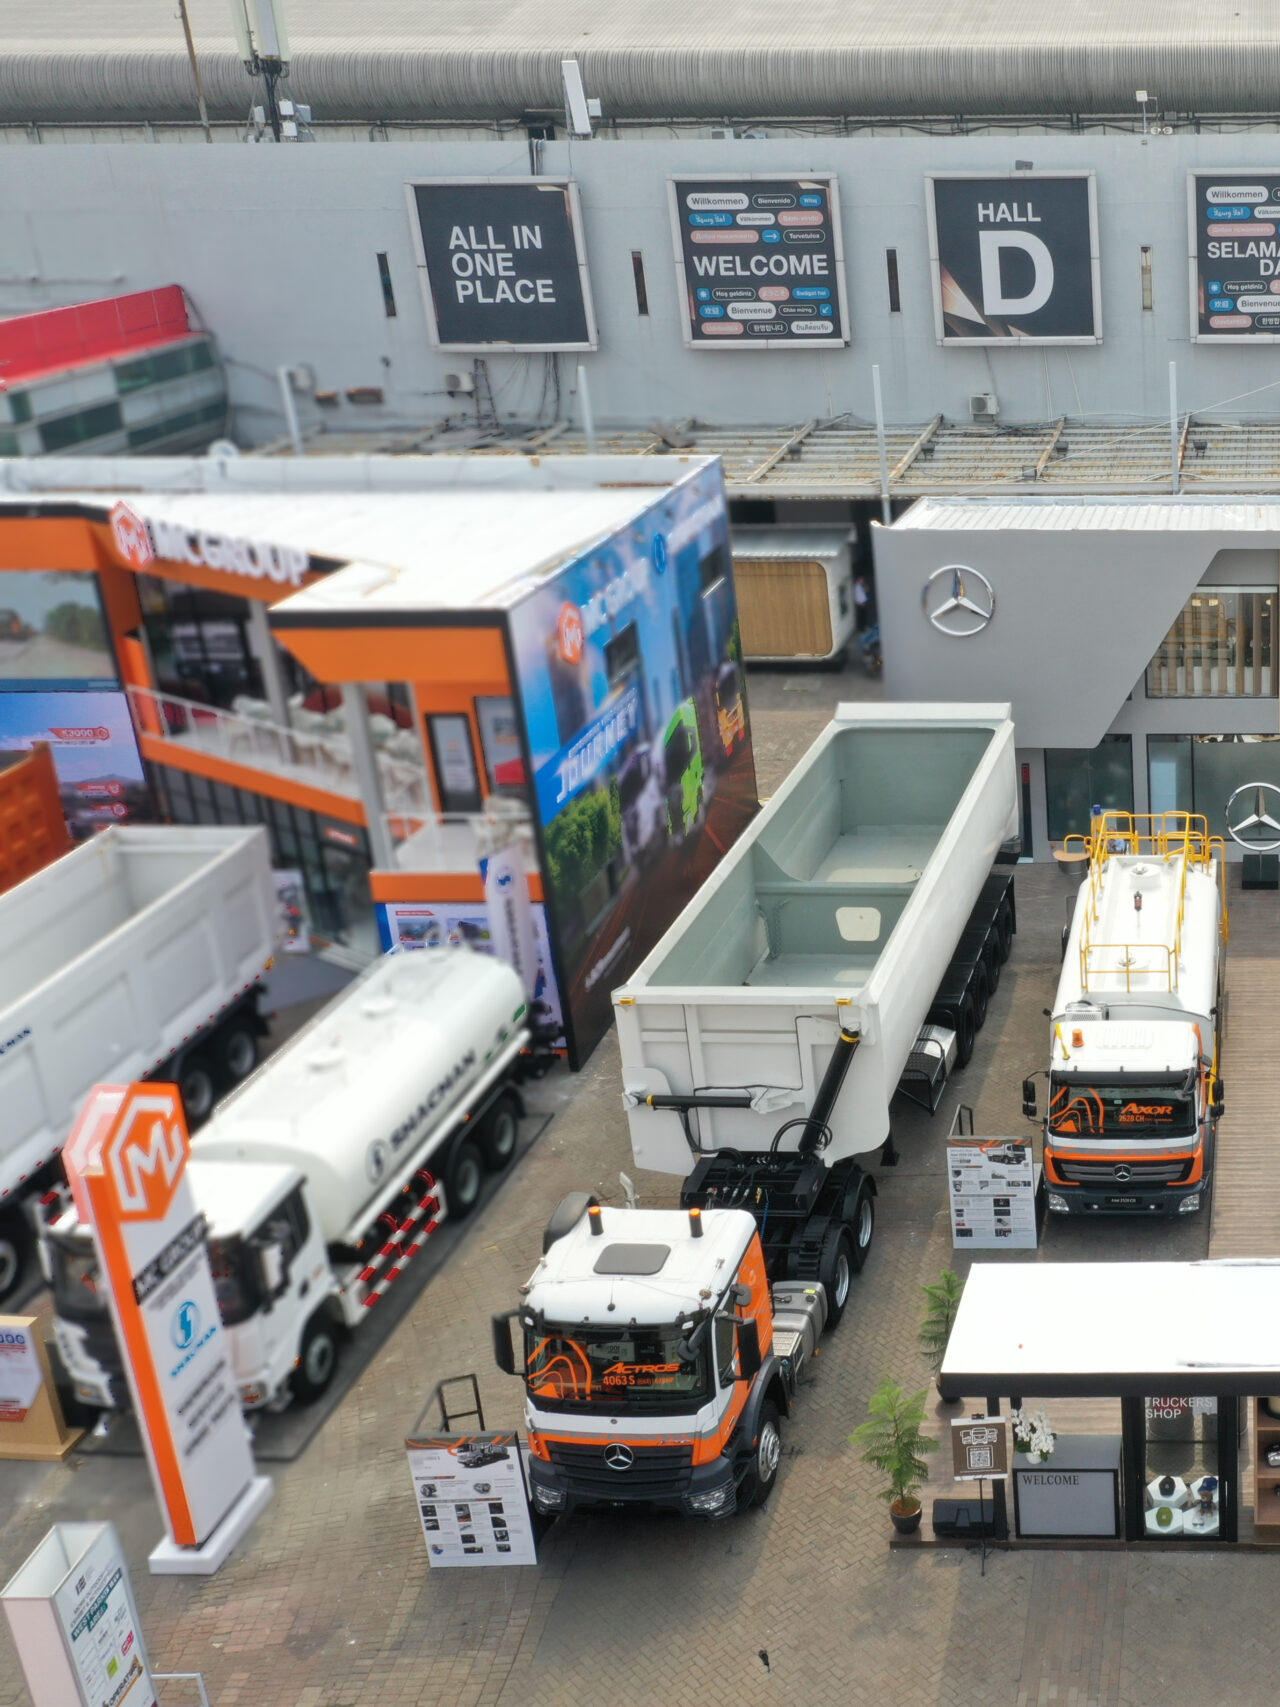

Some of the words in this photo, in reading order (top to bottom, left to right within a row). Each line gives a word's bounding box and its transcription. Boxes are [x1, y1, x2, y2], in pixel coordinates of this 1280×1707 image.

[691, 197, 744, 205] Willkommen
[977, 202, 1042, 222] HALL
[449, 226, 506, 250] ALL
[514, 225, 543, 249] IN
[451, 252, 516, 277] ONE
[692, 254, 829, 277] WELCOME
[979, 230, 1054, 316] D
[455, 279, 556, 304] PLACE
[731, 306, 773, 314] Bienvenue
[603, 1375, 627, 1386] 4063
[628, 1374, 636, 1386] S
[1144, 1397, 1213, 1408] TRUCKERS
[1145, 1408, 1182, 1419] SHOP
[1022, 1474, 1080, 1486] WELCOME
